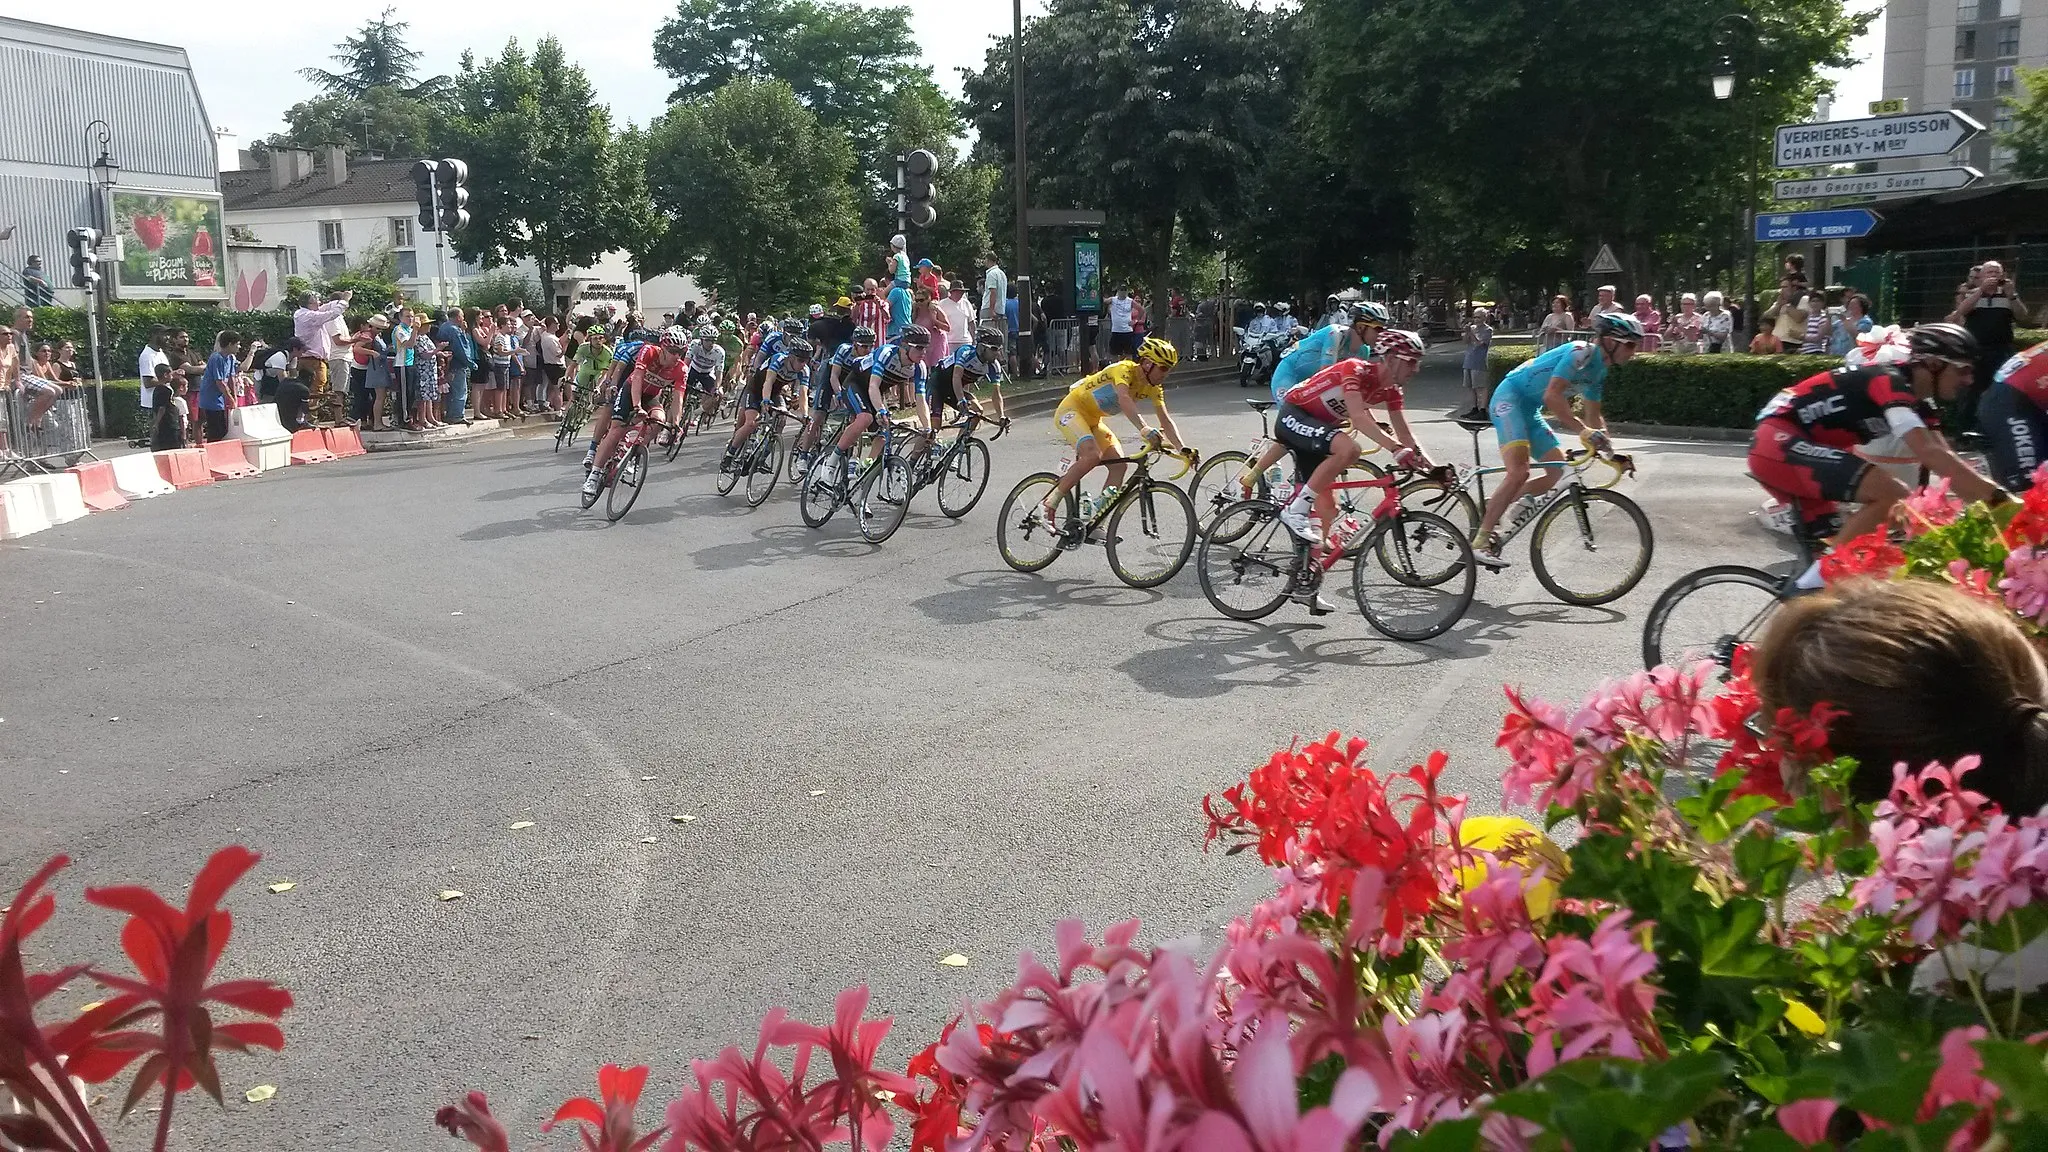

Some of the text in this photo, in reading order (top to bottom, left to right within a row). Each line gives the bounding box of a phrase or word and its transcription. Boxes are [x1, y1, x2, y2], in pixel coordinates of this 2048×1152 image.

[1781, 184, 1819, 196] Stade
[1825, 181, 1879, 193] Georges
[1768, 225, 1853, 237] CROIX DE BERNY
[153, 267, 188, 282] PLAISIR
[1797, 394, 1848, 424] BMC
[1790, 440, 1849, 460] BMC
